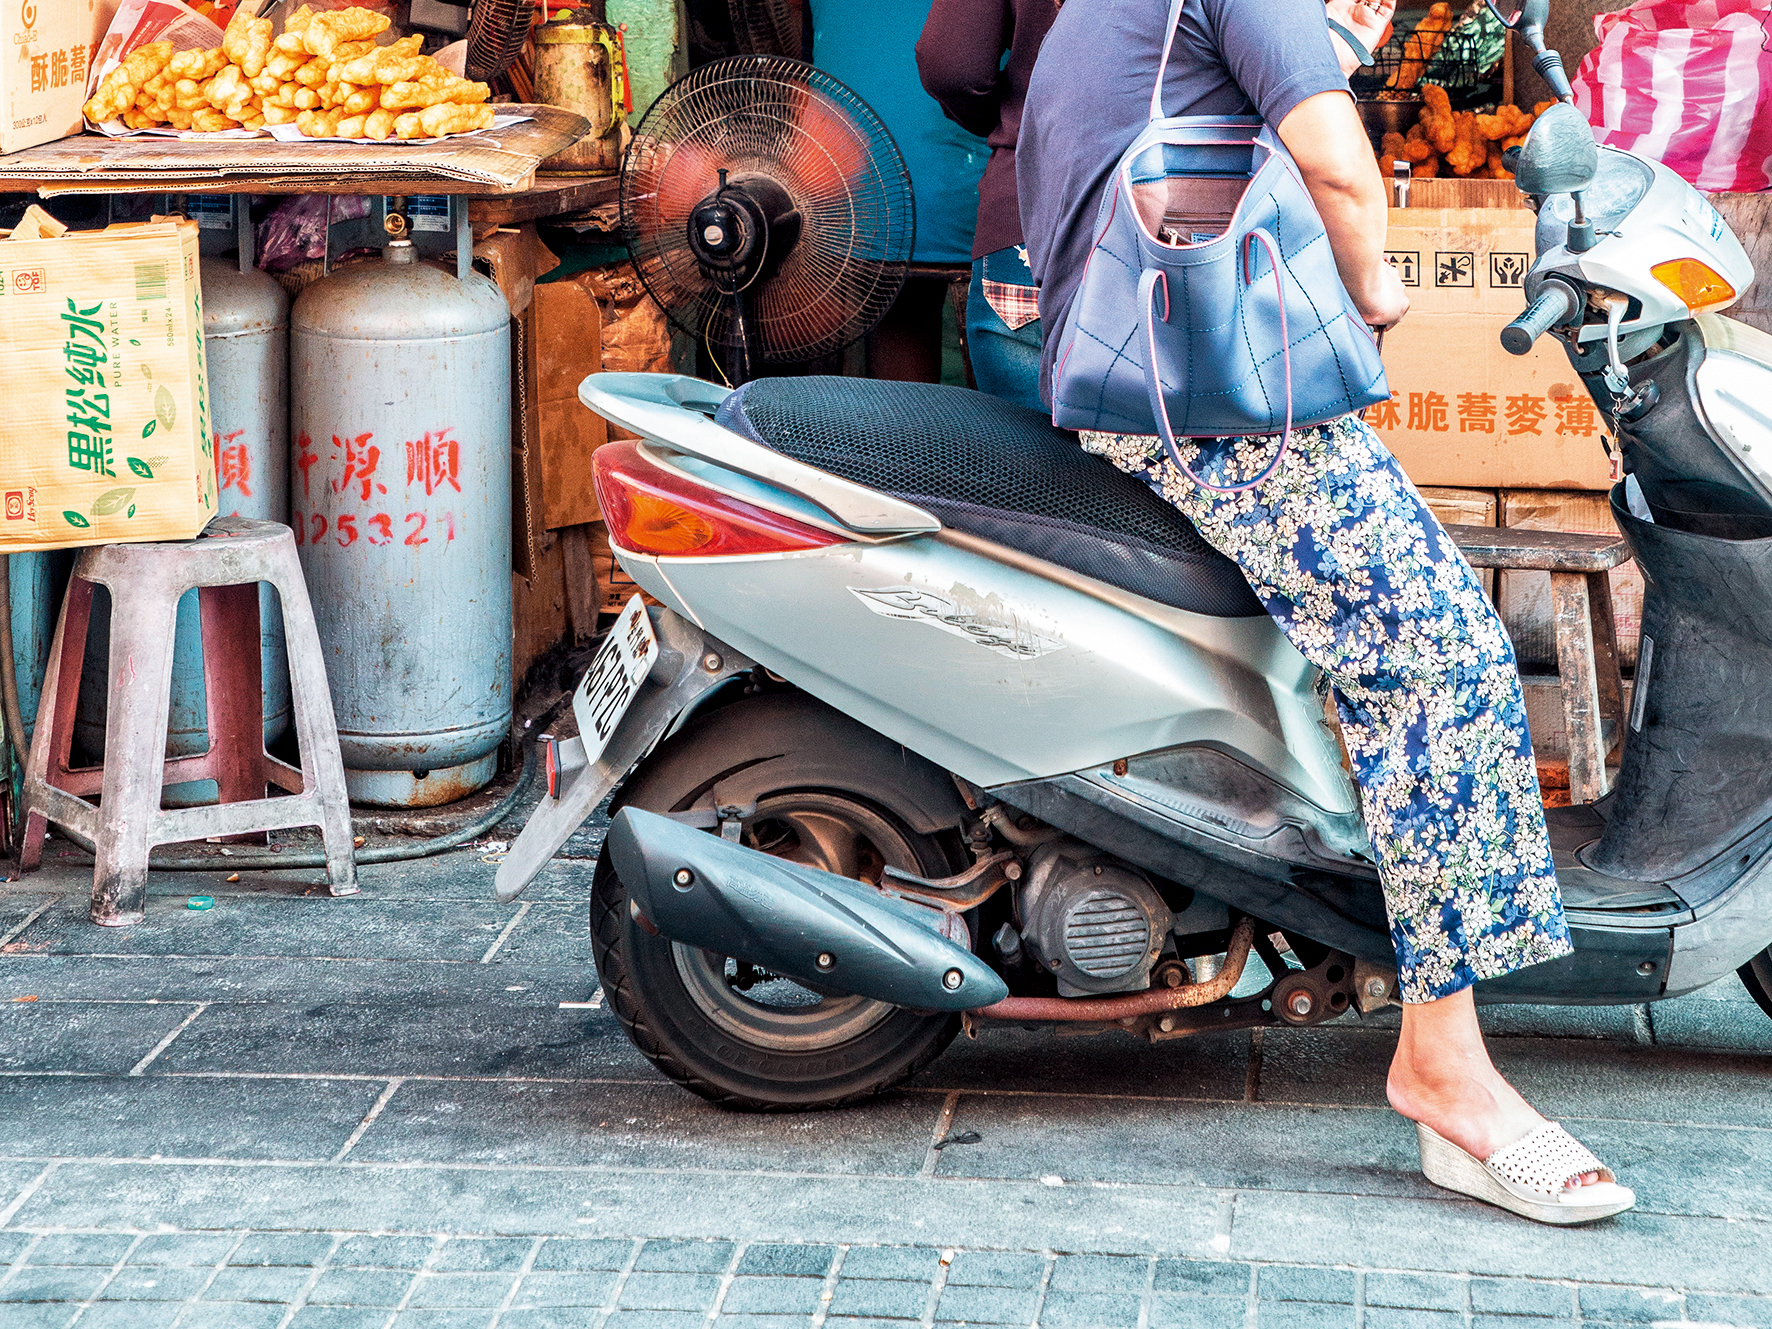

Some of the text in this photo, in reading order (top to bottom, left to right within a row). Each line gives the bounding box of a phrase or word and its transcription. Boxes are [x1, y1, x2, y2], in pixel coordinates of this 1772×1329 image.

[60, 296, 117, 479] 黑松純水
[109, 301, 122, 388] PURE WATER
[1365, 389, 1613, 439] 酥脆蕎麥薄
